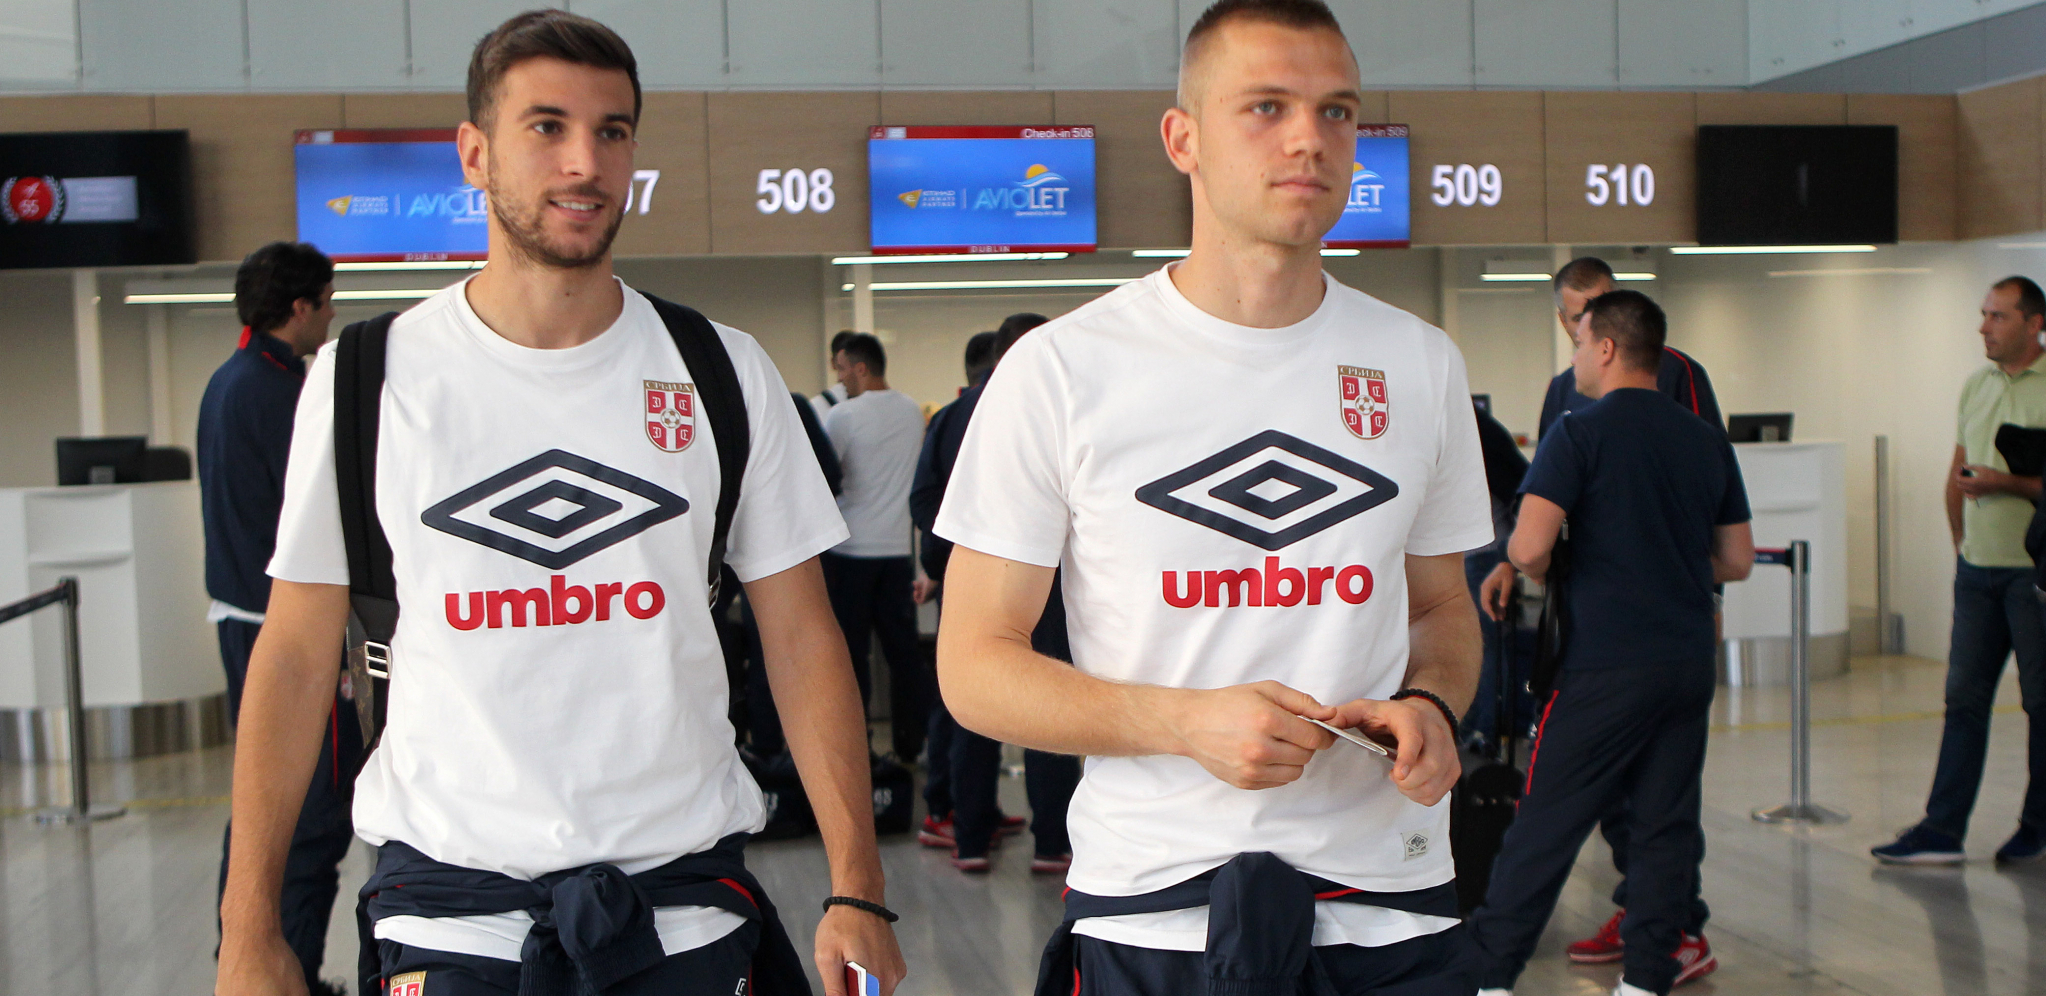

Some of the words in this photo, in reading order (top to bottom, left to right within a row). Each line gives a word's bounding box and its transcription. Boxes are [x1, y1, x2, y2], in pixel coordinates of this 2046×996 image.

[1022, 128, 1070, 138] Check-in
[1072, 127, 1094, 138] 508
[624, 169, 661, 215] 7
[756, 168, 835, 213] 508
[974, 187, 1069, 209] AVIOLET
[1432, 164, 1503, 207] 509
[1586, 164, 1656, 206] 510
[970, 245, 1011, 253] DUBLIN
[445, 574, 666, 631] umbro
[1162, 555, 1374, 609] umbro
